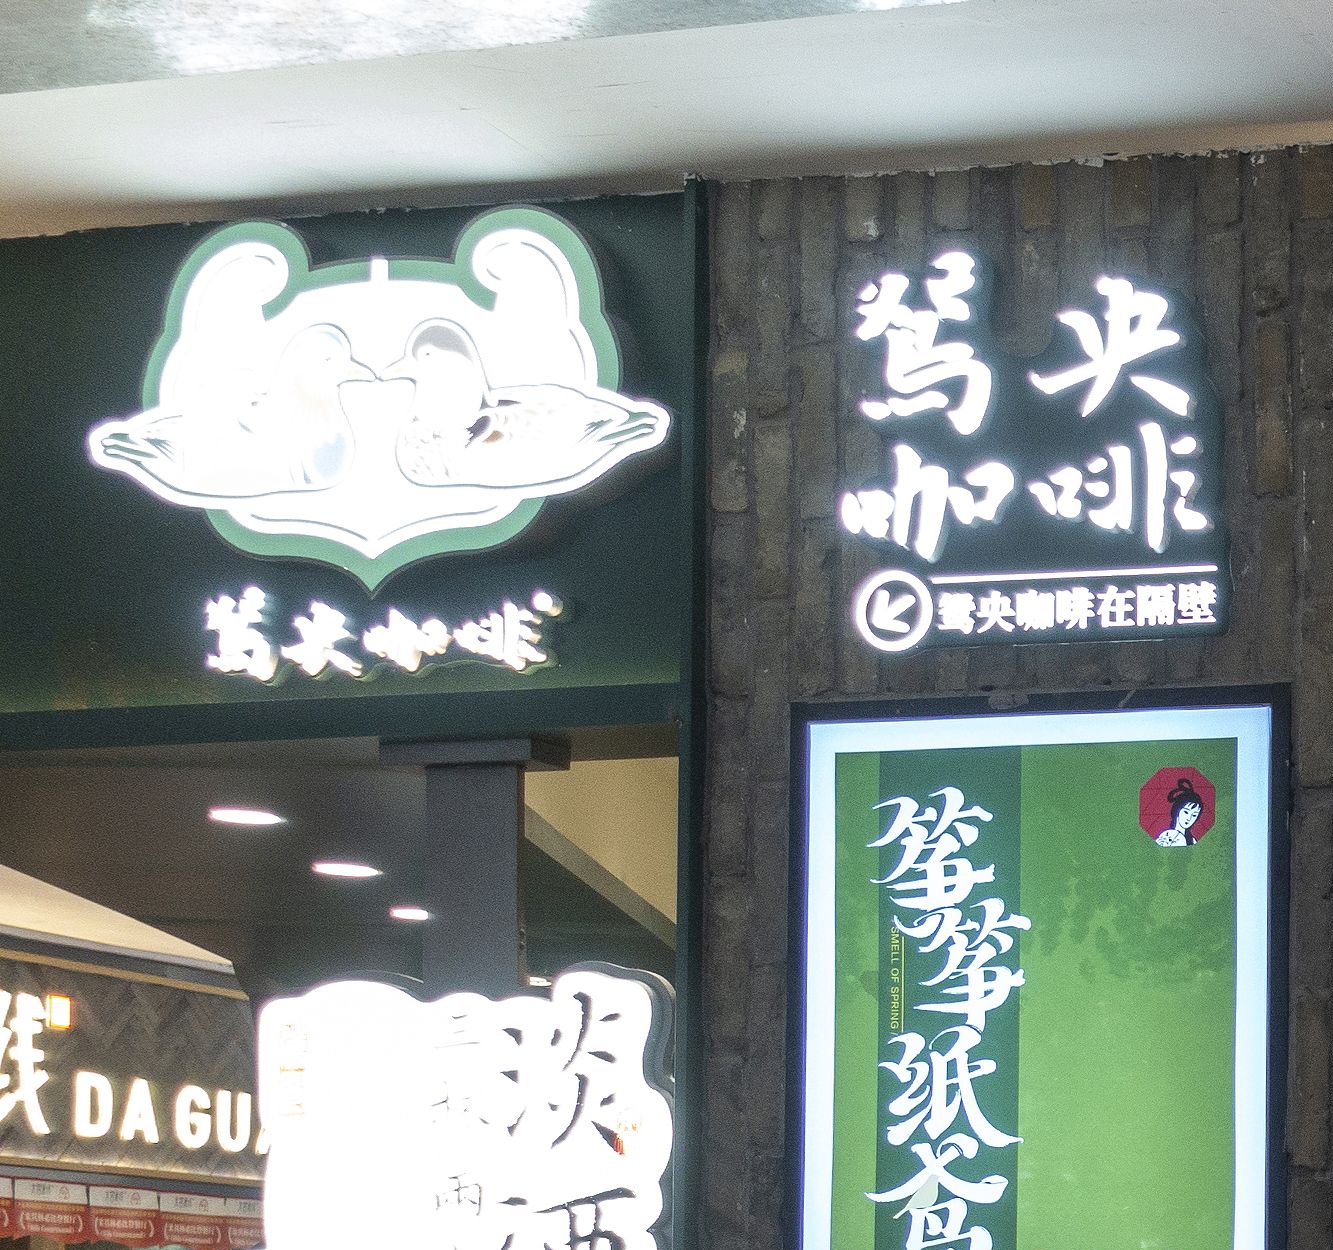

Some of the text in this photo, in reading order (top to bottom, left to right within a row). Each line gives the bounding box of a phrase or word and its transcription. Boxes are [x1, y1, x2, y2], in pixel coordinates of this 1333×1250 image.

[841, 423, 1212, 562] 咖啡
[890, 926, 900, 1029] SMELL OF SPRING
[74, 1071, 271, 1156] DA GU
